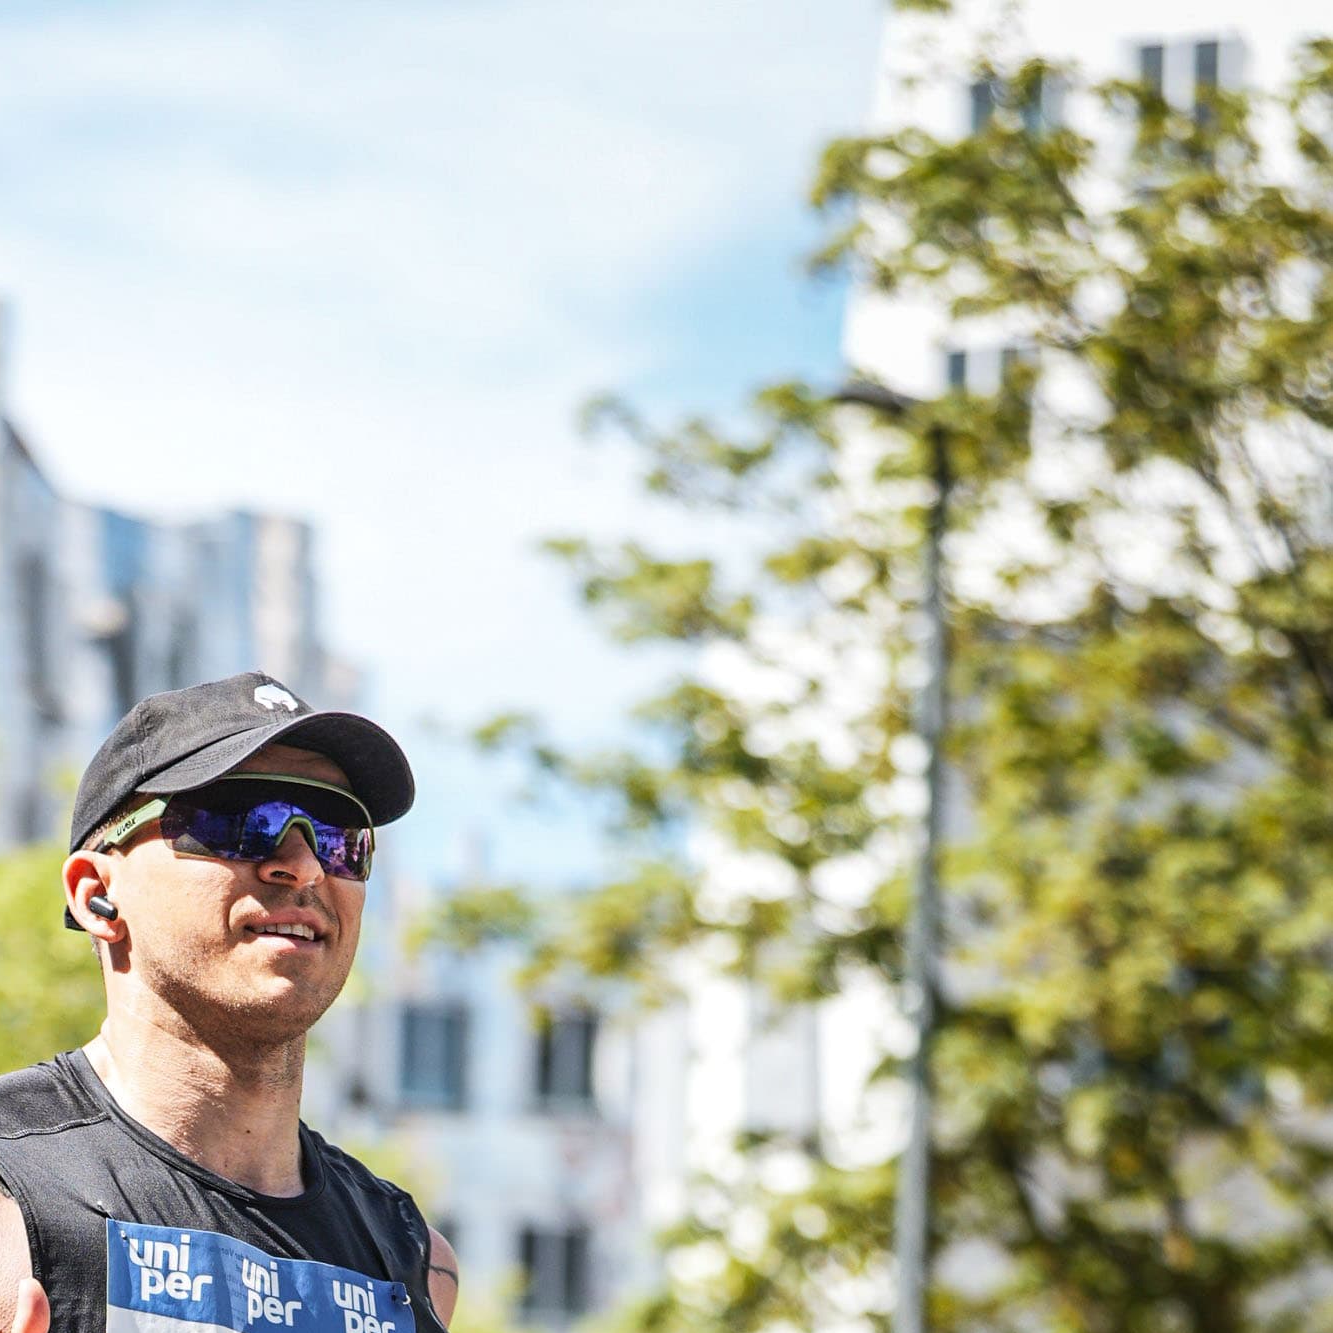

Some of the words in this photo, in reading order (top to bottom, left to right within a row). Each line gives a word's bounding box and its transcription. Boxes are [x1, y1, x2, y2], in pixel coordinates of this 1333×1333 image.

[129, 1234, 191, 1272] uni
[140, 1266, 213, 1302] per
[242, 1258, 280, 1298] uni
[247, 1289, 302, 1327] per
[332, 1280, 377, 1318] uni
